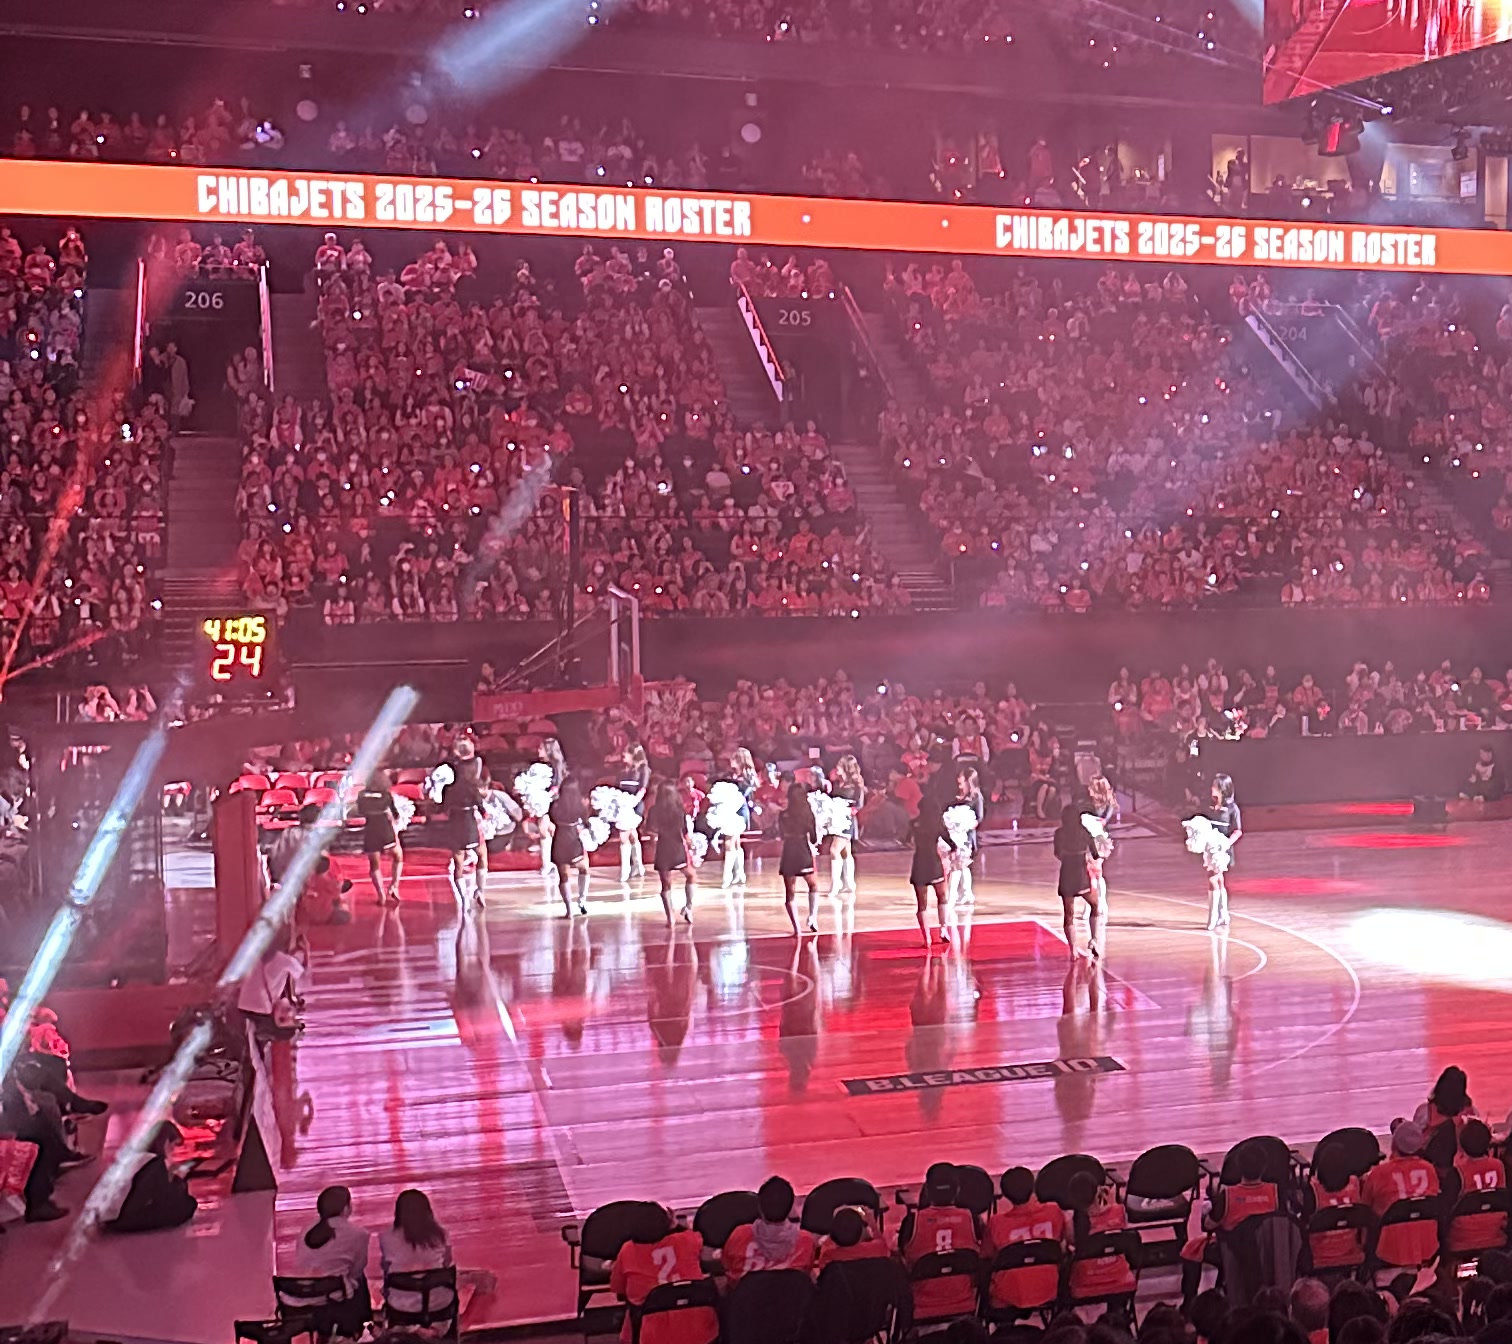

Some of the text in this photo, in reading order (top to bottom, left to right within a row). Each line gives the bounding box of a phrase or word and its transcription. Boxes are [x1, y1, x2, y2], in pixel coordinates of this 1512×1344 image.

[196, 175, 751, 237] CHIBAJETS 2025-26 SEASON ROSTER
[995, 215, 1437, 267] CHIBAJETS 2025-26 SEASON ROSTER
[184, 291, 224, 309] 206
[778, 309, 812, 326] 205
[1279, 326, 1308, 342] 204
[204, 616, 267, 643] 41:05
[212, 644, 262, 680] 24
[864, 1057, 1100, 1092] B.LEAGUE 10
